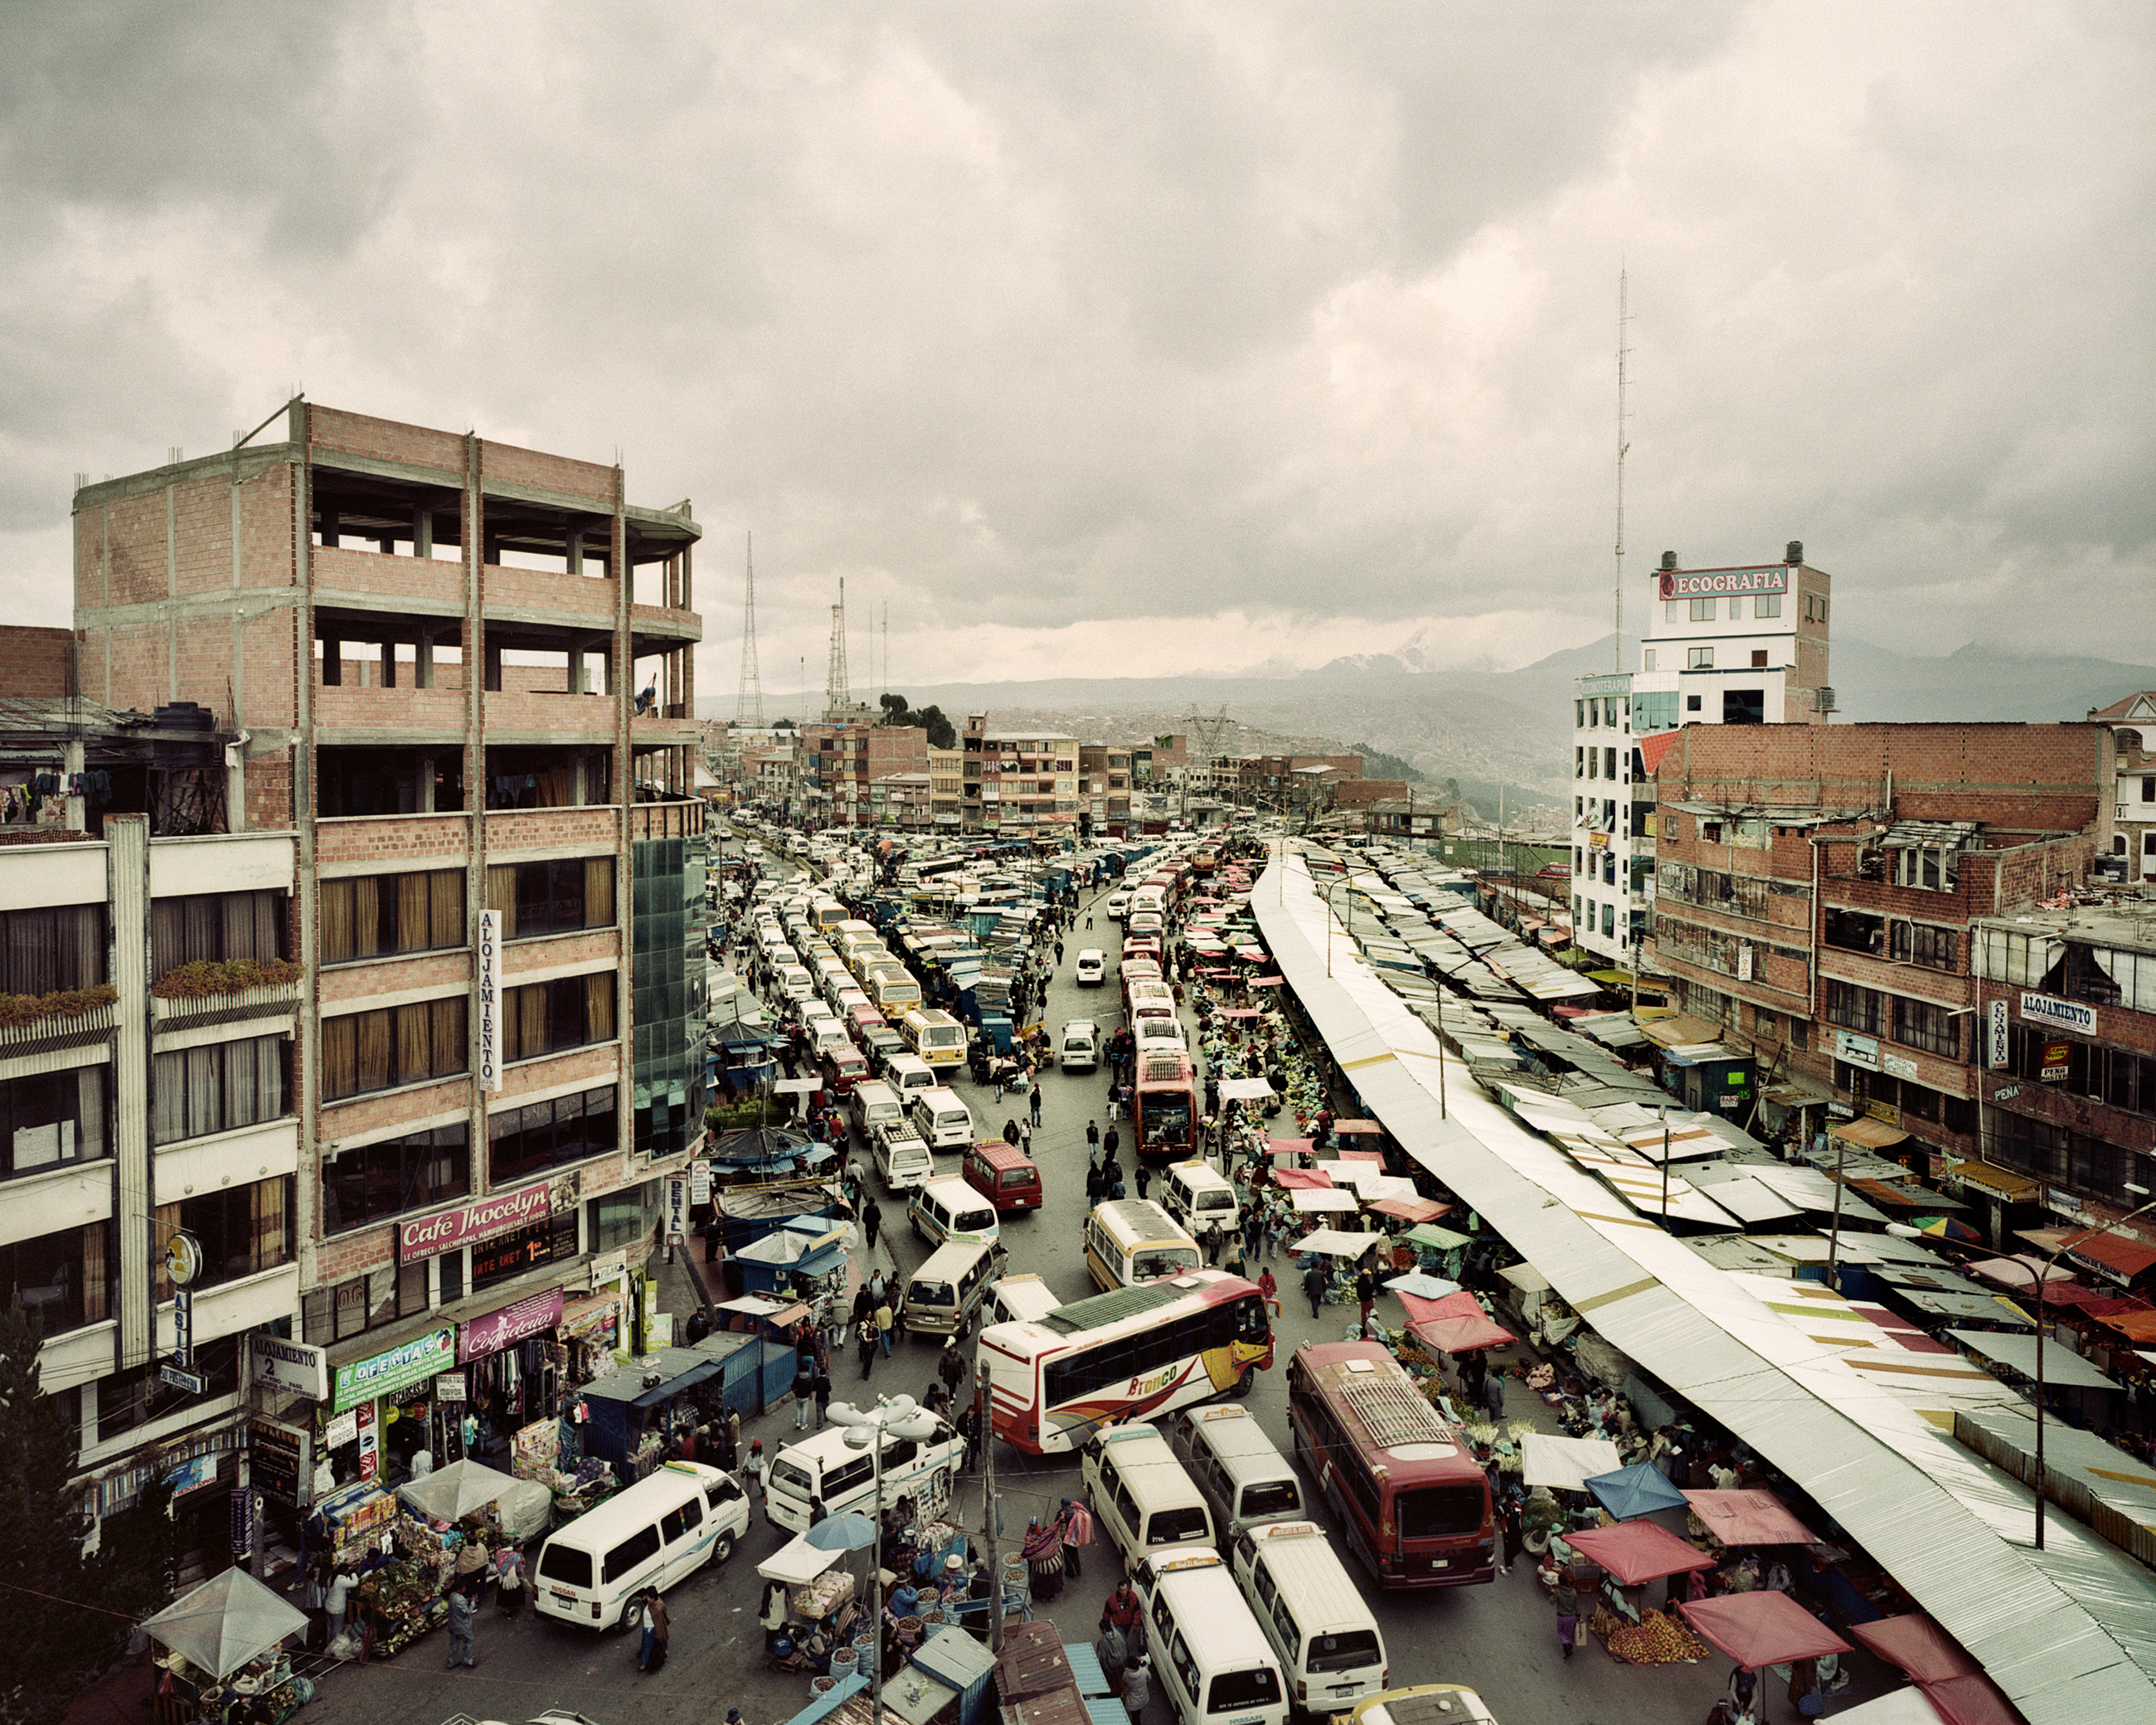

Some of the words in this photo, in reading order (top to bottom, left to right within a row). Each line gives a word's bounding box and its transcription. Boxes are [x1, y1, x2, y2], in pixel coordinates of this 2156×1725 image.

[1677, 571, 1785, 594] ECOGRAFIA
[481, 913, 493, 1078] ALOJAMIENTO
[2023, 996, 2090, 1025] ALOJAMIENTO
[1994, 1002, 2005, 1062] ALOJAMIENTO
[403, 1216, 454, 1246] Café
[459, 1190, 547, 1236] Jhocelyn
[671, 1181, 682, 1232] DENTAL
[404, 1253, 411, 1261] LE
[479, 1219, 522, 1238] HAMBURGUESAS
[529, 1211, 546, 1222] JUGOS
[175, 1294, 183, 1365] ASIS
[255, 1339, 315, 1368] ALOJAMIENTO
[356, 1336, 435, 1381] OFERTAS
[1126, 1365, 1177, 1397] Bronco
[551, 1585, 575, 1597] NISSAN
[1229, 1714, 1262, 1725] NISSAN
